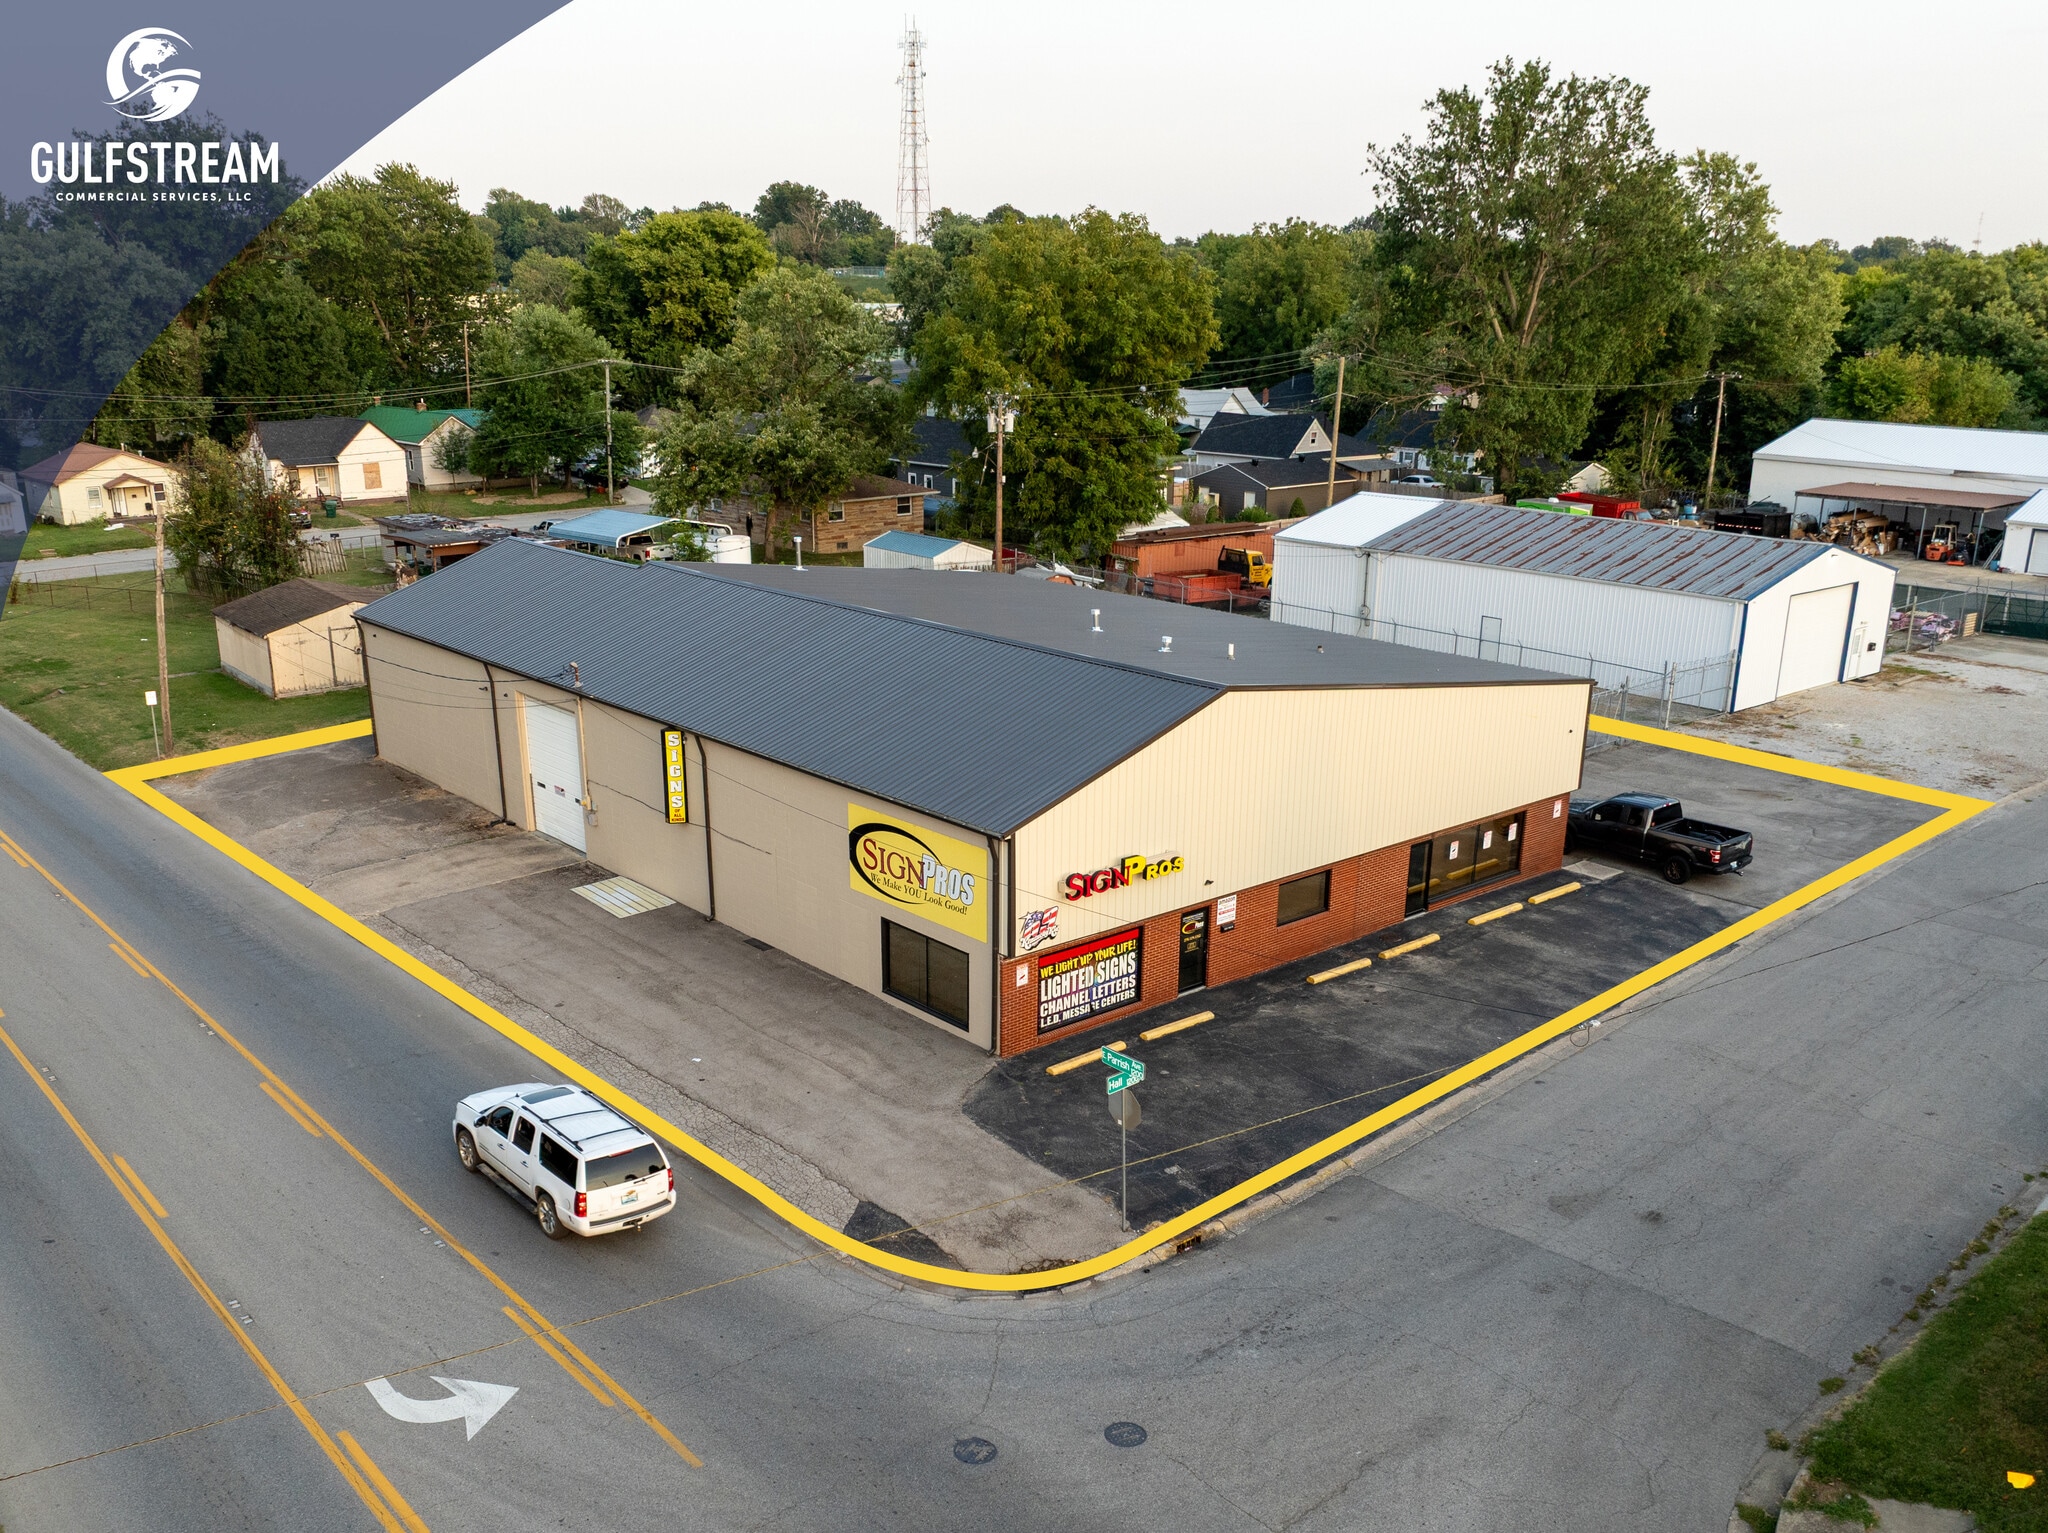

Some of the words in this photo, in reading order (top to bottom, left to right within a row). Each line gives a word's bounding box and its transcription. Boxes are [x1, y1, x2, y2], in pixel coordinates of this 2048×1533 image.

[667, 733, 683, 808] SIGNS
[870, 872, 881, 884] We
[882, 875, 902, 892] Make
[903, 884, 923, 899] YOU
[923, 891, 943, 906] Look
[944, 899, 968, 916] Good!
[1040, 966, 1054, 979] WE
[1055, 957, 1079, 973] LIGHT
[1080, 952, 1093, 966] UP
[1094, 945, 1116, 962] YOUR
[1116, 939, 1137, 955] LIFE!
[1040, 965, 1094, 1003] LIGHTED
[1096, 951, 1137, 984] SIGNS
[1040, 990, 1090, 1017] CHANNEL
[1092, 974, 1136, 1001] LETTERS
[1040, 1013, 1061, 1028] L.E.D.
[1101, 988, 1136, 1008] CENTERS
[1107, 1052, 1130, 1071] Parrish
[1109, 1077, 1123, 1091] Hall
